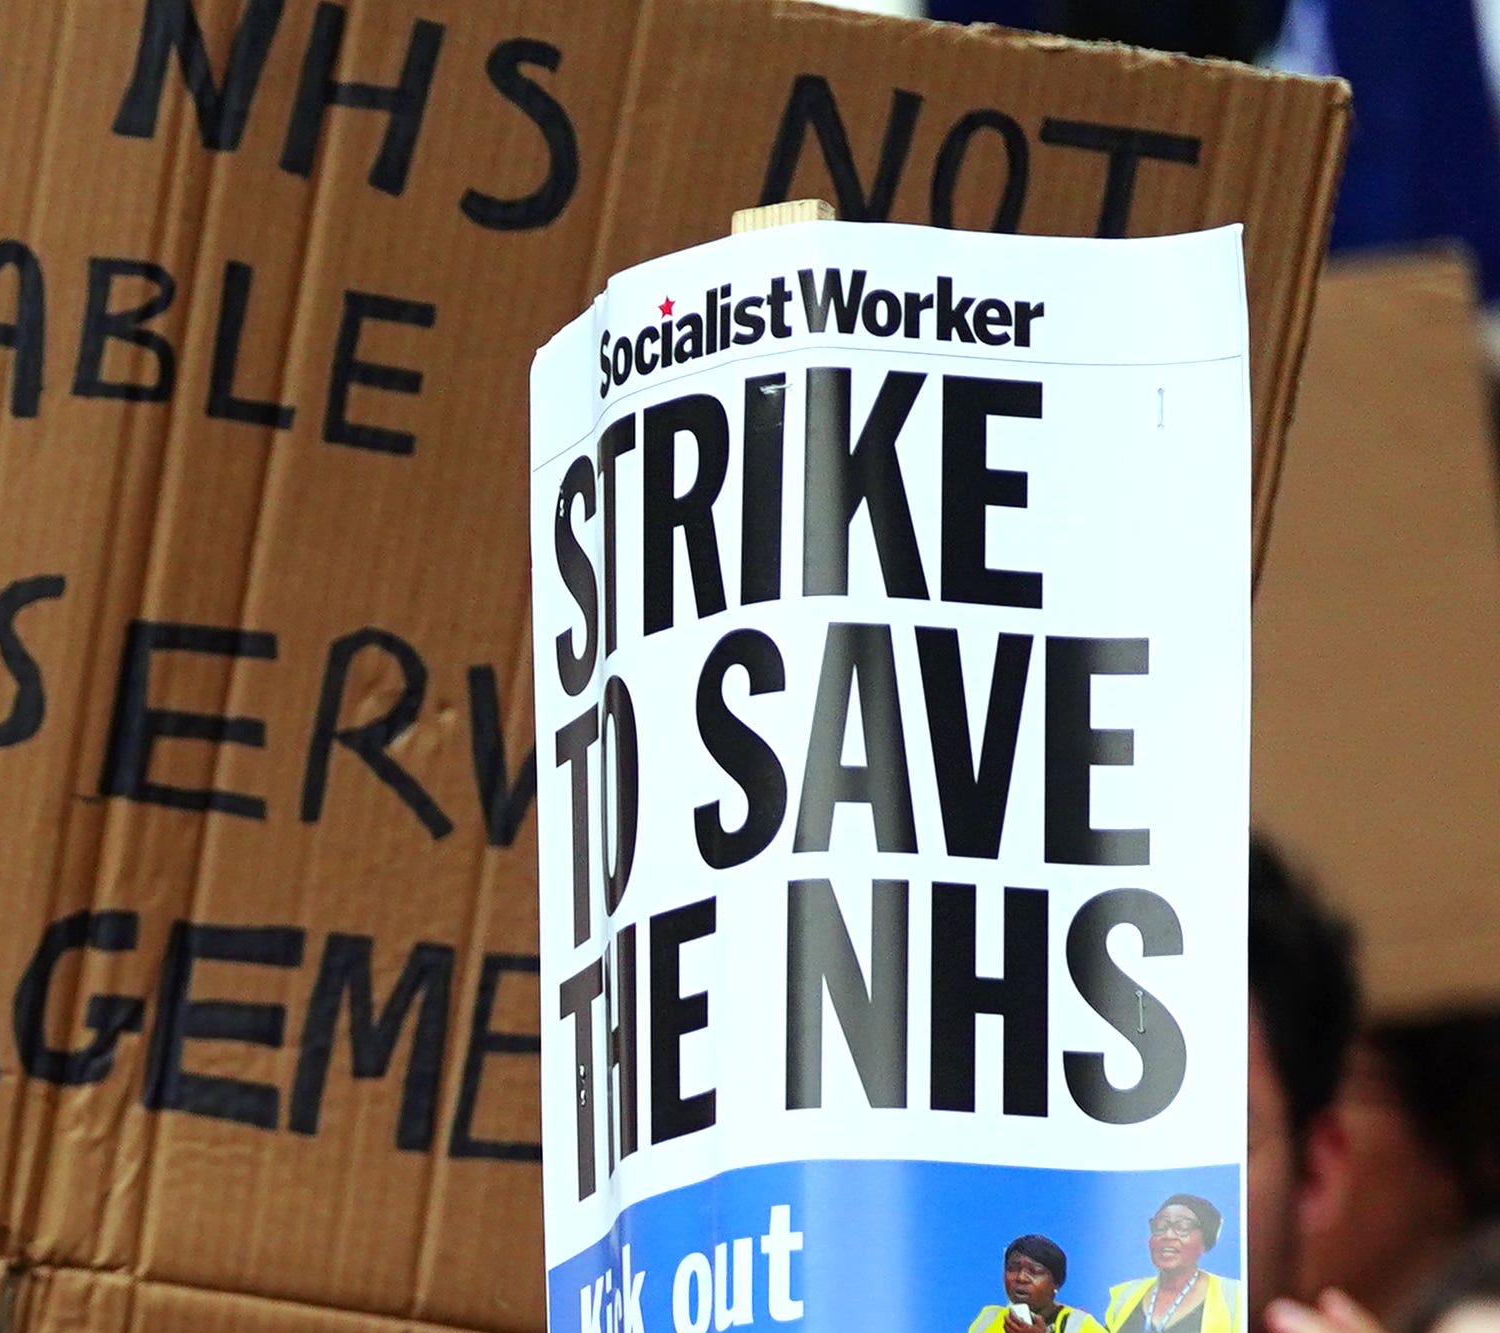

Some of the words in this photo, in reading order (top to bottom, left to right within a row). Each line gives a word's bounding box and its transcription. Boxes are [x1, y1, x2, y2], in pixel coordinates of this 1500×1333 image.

[112, 0, 581, 230] NHS
[761, 73, 1200, 238] NOT
[600, 276, 792, 398] Socialist
[798, 268, 1044, 348] Worker
[555, 367, 1043, 697] STRIKE
[556, 675, 638, 949] TO
[694, 622, 1151, 870] SAVE
[560, 895, 716, 1202] THE
[786, 874, 1186, 1125] NHS
